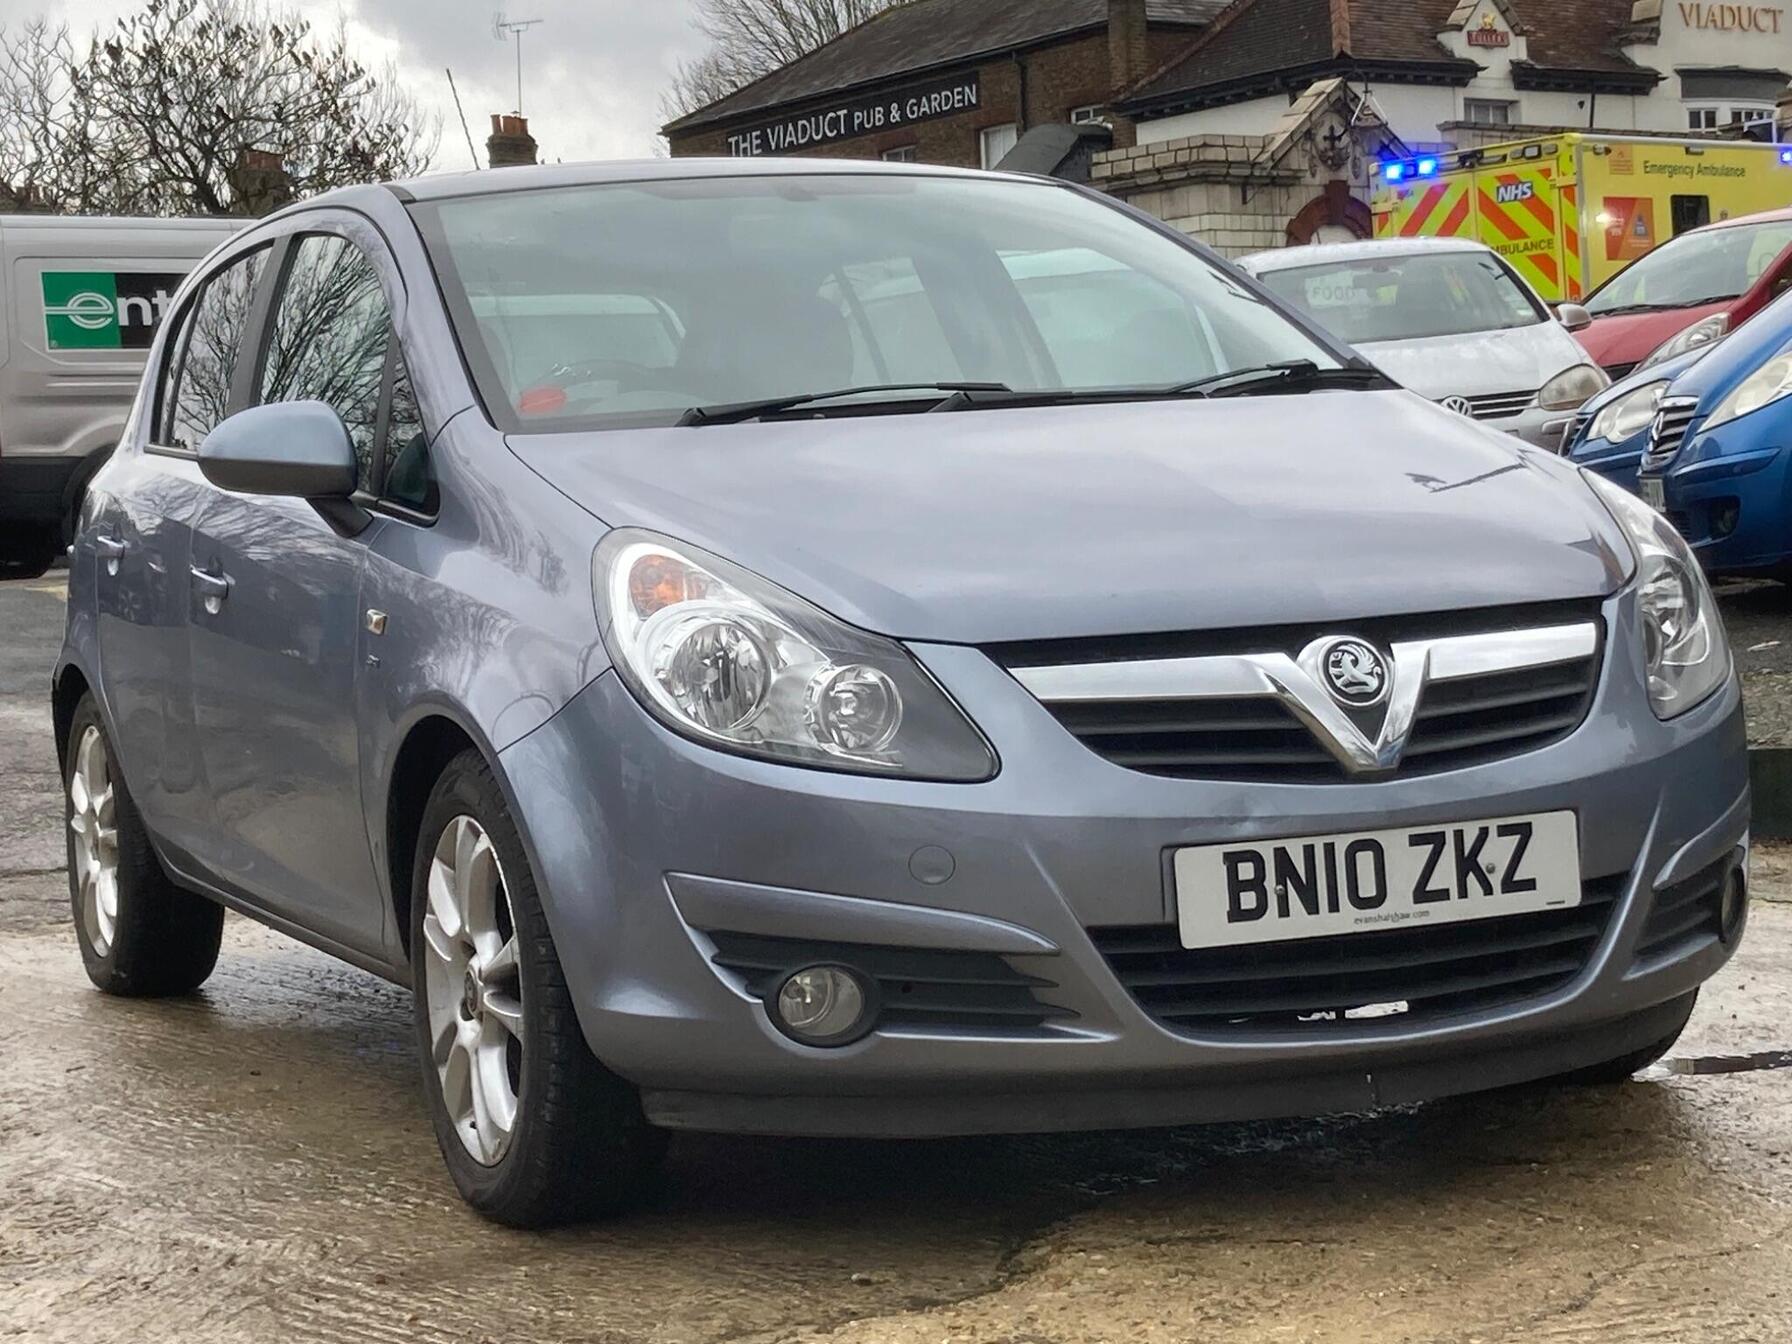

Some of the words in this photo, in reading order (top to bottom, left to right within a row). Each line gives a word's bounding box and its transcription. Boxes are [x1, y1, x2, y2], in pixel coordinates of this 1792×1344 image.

[1678, 3, 1784, 34] VIADUCT
[728, 130, 761, 157] THE
[767, 109, 848, 150] VIADUCT
[854, 106, 883, 131] PUB
[890, 102, 901, 123] &
[906, 84, 977, 119] GARDEN
[1643, 160, 1694, 179] Emergency
[1696, 163, 1746, 177] Ambulance
[1498, 182, 1532, 202] NHS
[1490, 238, 1554, 256] MBULANCE
[1223, 838, 1388, 923] BN10
[1408, 822, 1537, 904] ZKZ
